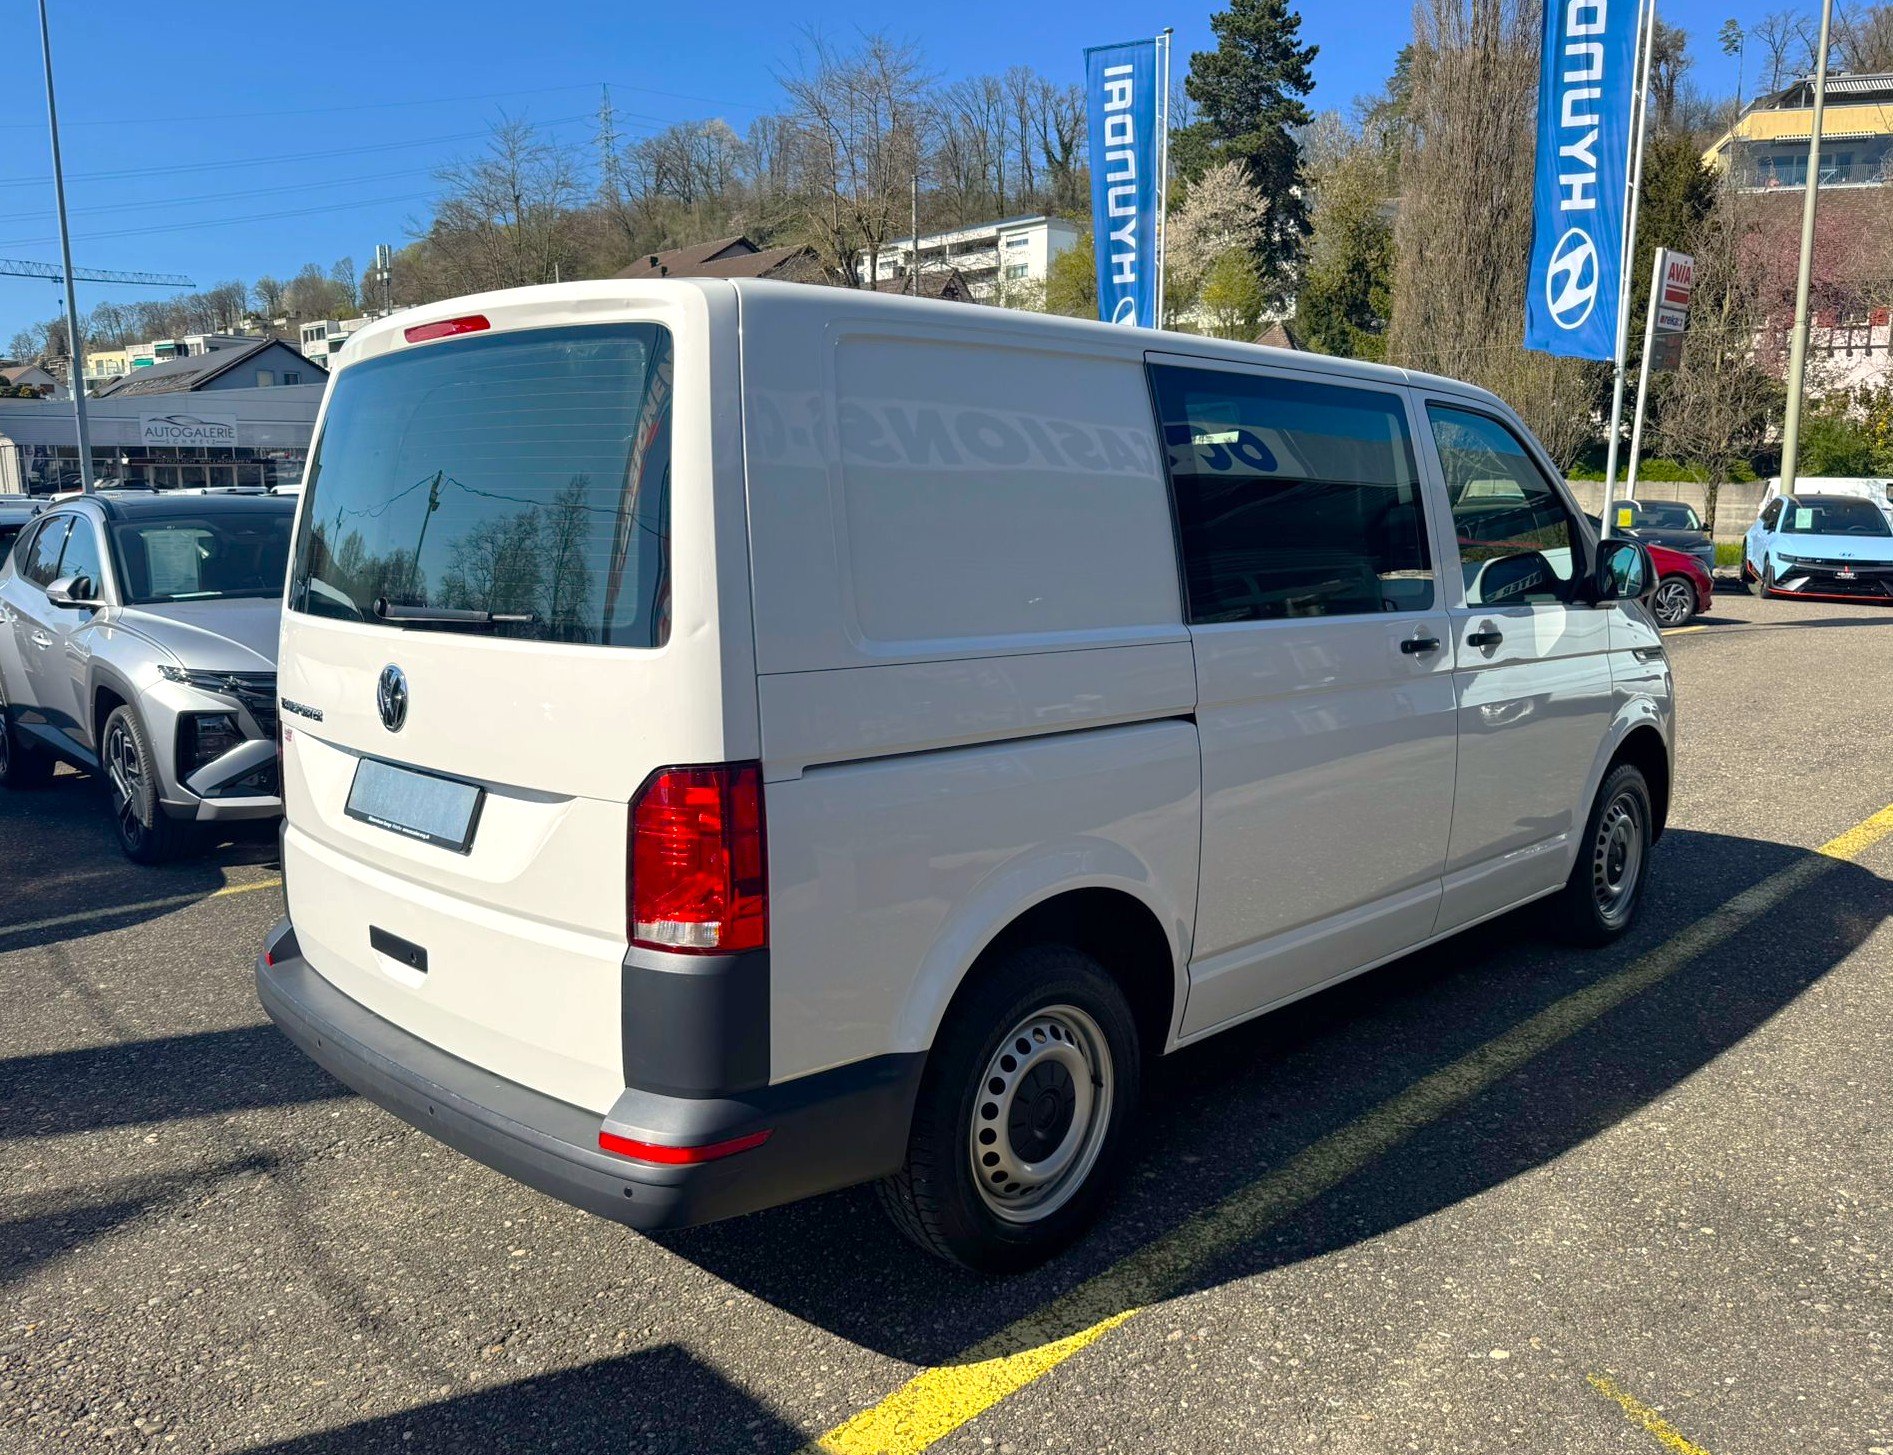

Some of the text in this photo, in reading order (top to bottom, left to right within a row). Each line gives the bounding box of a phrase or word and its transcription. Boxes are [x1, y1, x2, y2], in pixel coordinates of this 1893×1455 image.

[1104, 64, 1136, 284] HYUNDAI
[1667, 261, 1691, 285] AVIA
[144, 427, 235, 439] AUTOGALERIE
